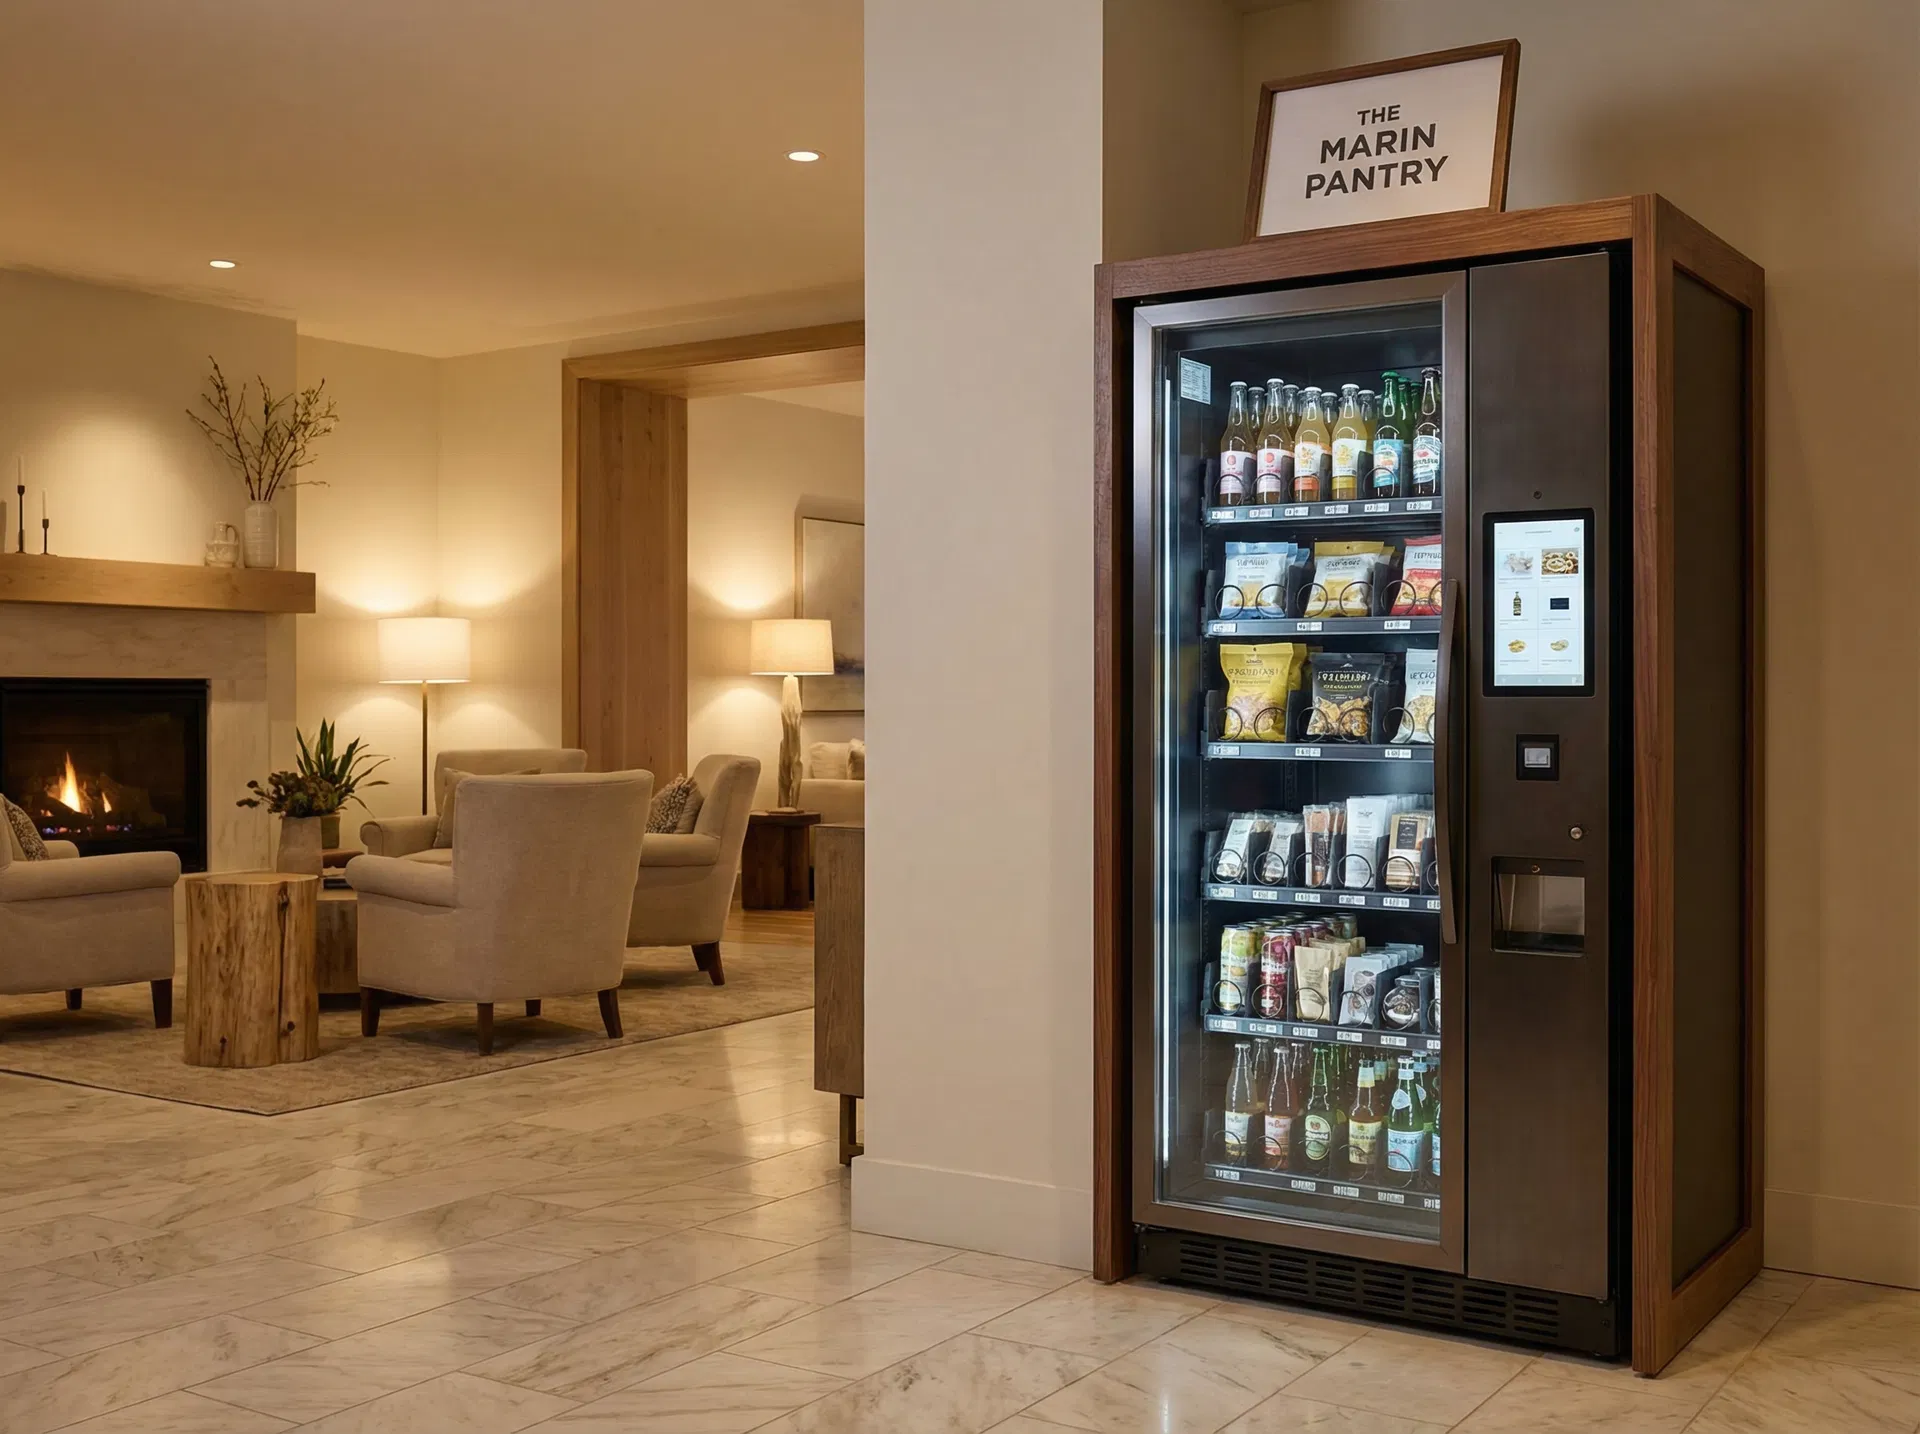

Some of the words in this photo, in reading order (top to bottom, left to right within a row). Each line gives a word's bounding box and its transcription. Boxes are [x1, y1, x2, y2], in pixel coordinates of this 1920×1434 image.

[1357, 104, 1401, 126] THE
[1320, 123, 1436, 164] MARIN
[1305, 155, 1449, 199] PANTRY
